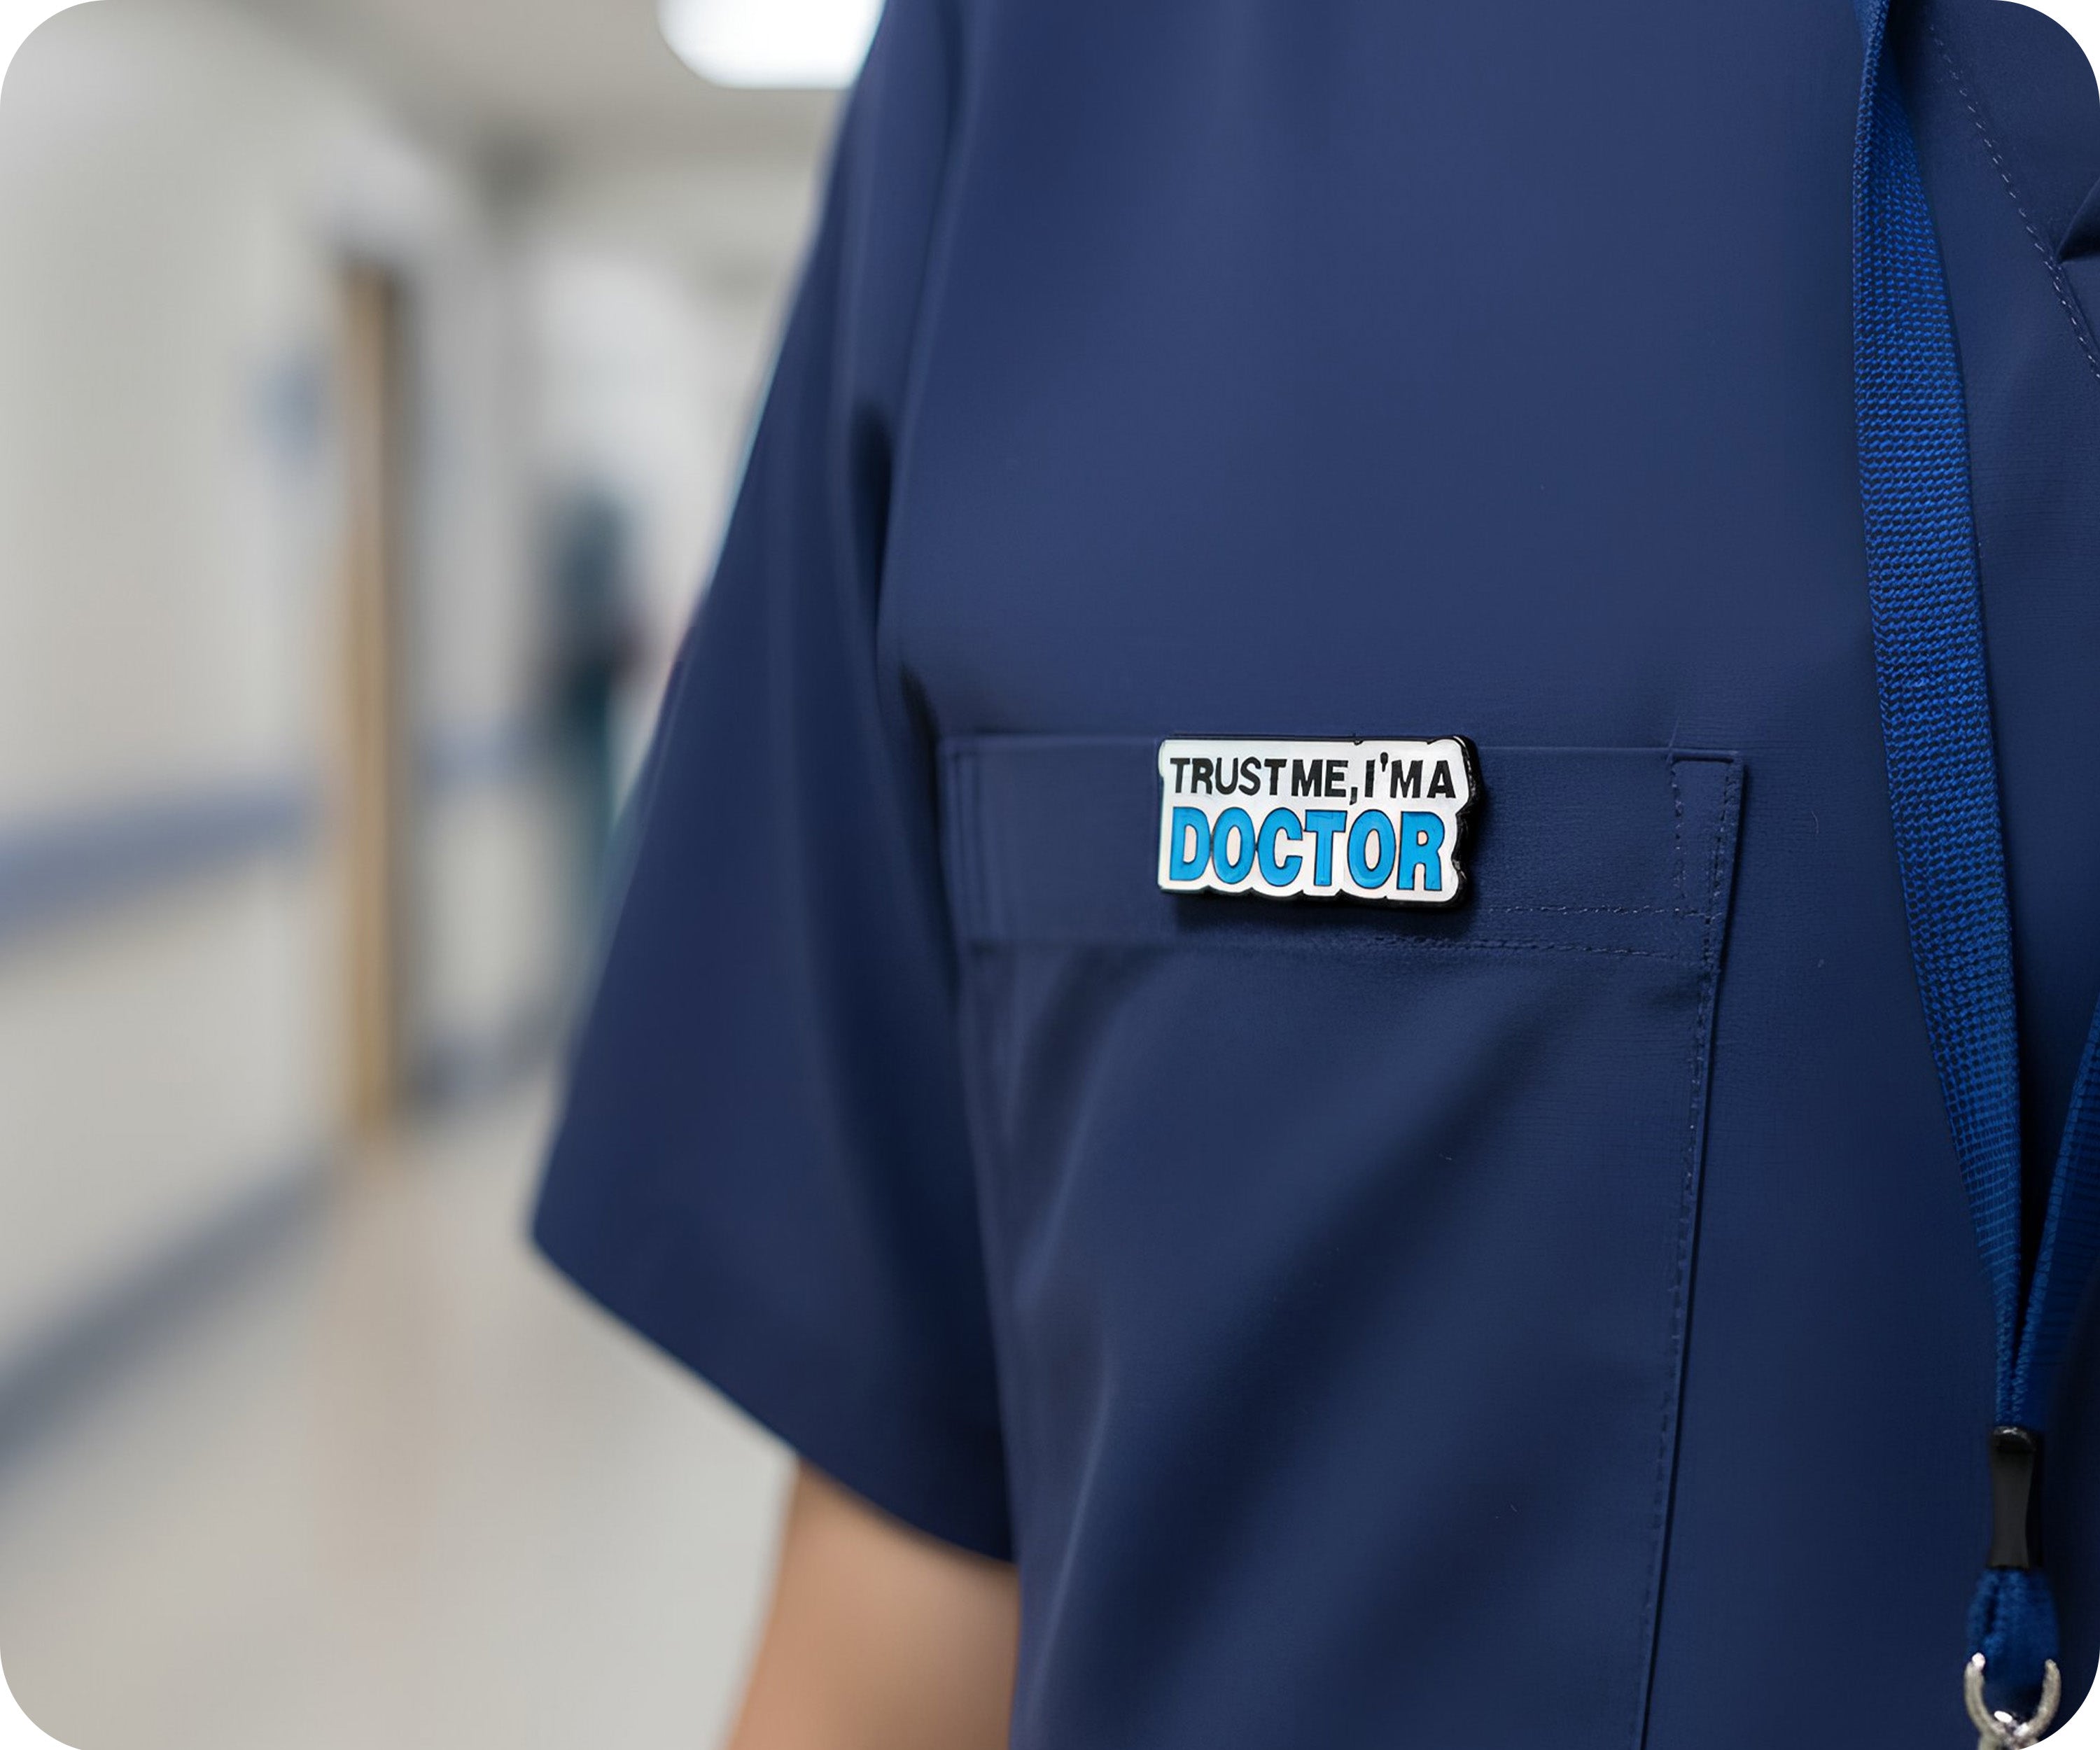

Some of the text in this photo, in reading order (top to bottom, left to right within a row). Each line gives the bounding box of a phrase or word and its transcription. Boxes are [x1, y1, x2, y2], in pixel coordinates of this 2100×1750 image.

[1170, 752, 1456, 805] TRUST ME, I'M A
[1169, 806, 1446, 892] DOCTOR
